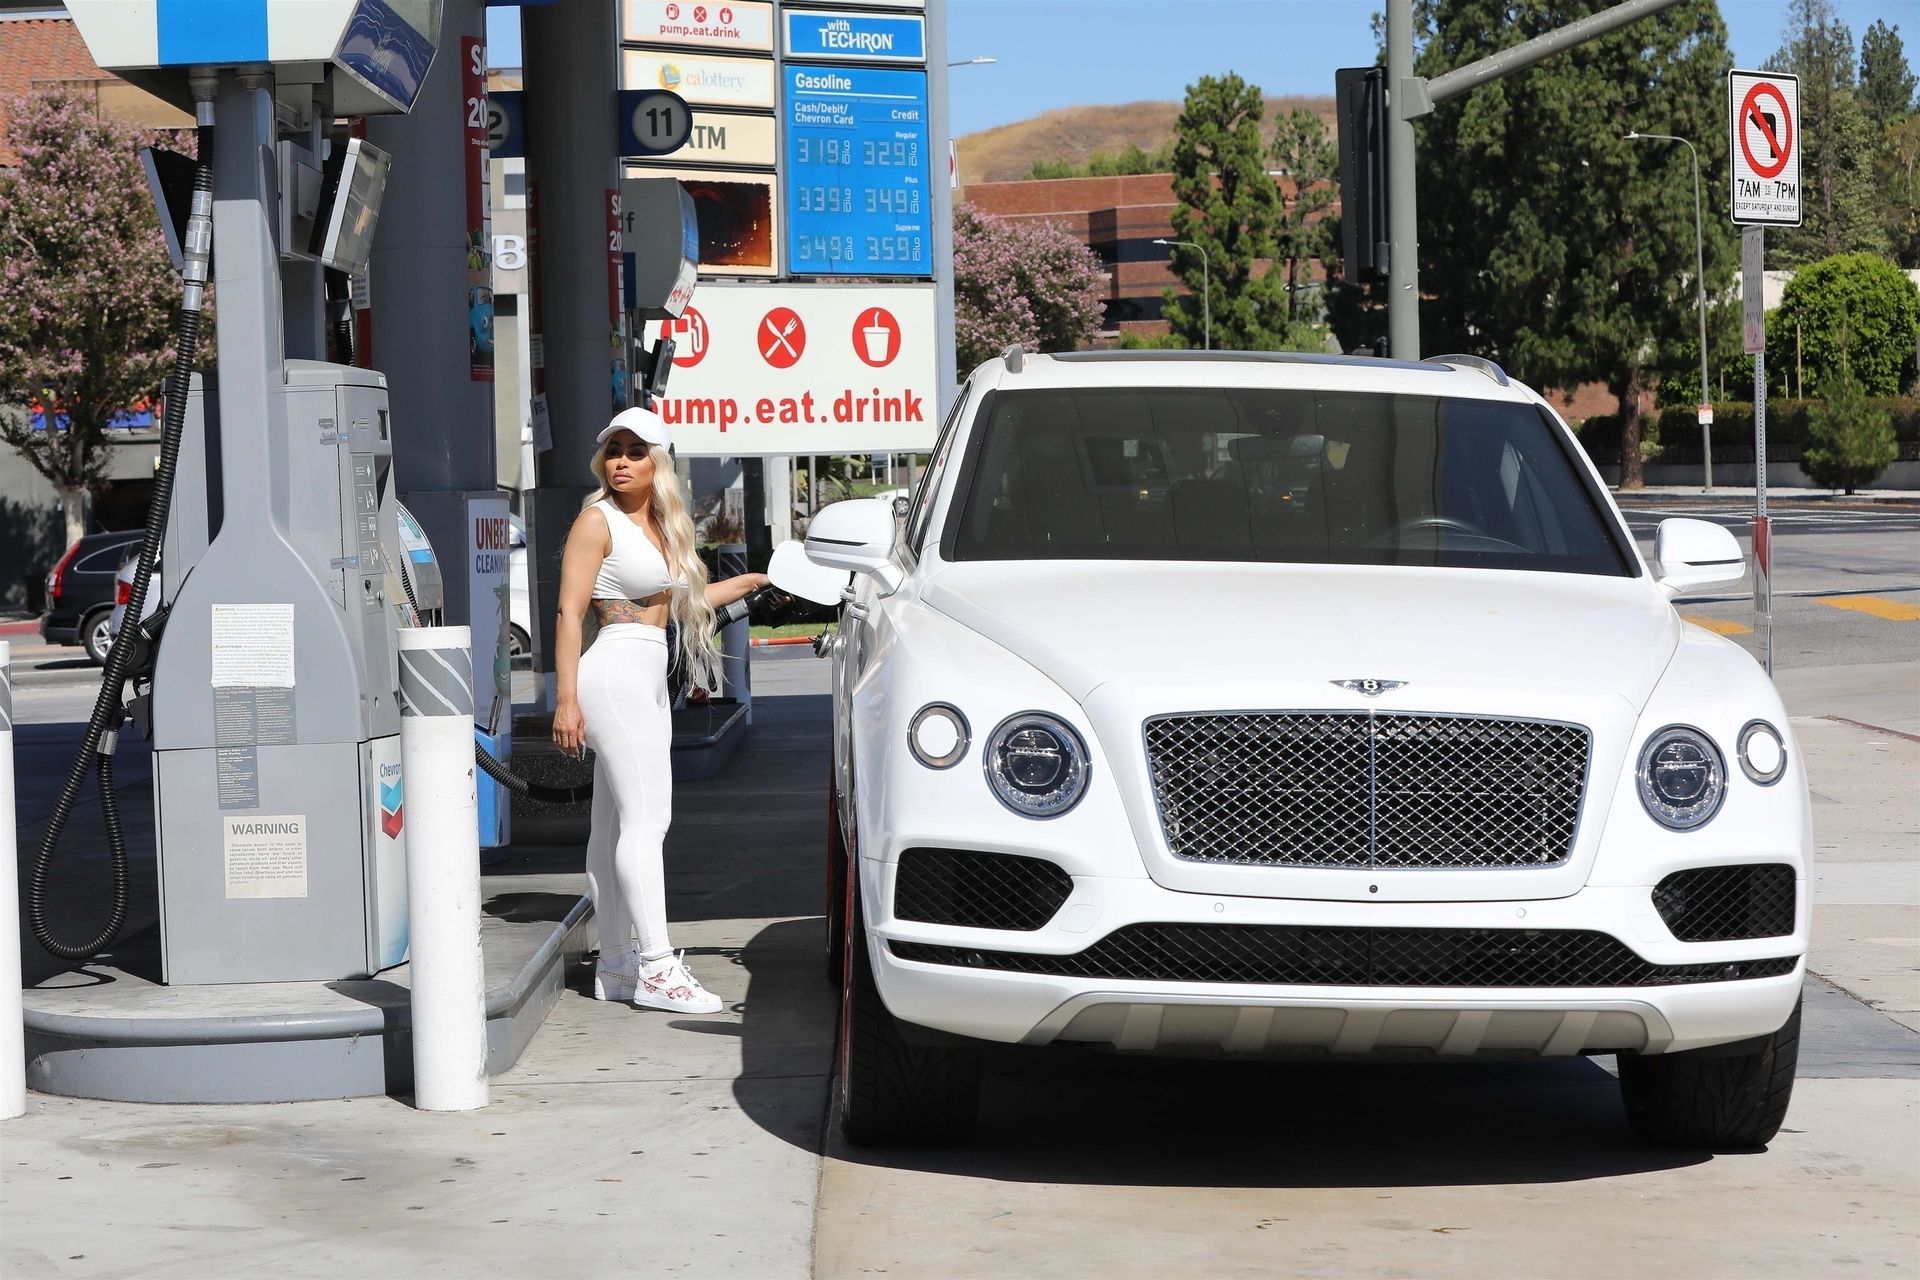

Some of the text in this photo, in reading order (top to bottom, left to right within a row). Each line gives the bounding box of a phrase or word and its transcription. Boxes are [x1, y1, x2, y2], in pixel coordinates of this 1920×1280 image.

[660, 25, 740, 38] pump.eat.drink
[827, 20, 850, 31] with
[818, 28, 893, 52] TECHRON
[686, 69, 745, 92] calottery
[795, 72, 852, 90] Gasoline
[795, 102, 848, 114] Cash/Debit/
[892, 110, 918, 120] Credit
[646, 108, 672, 137] 11
[795, 113, 854, 124] Chevron Card
[896, 132, 918, 140] Regular
[798, 138, 838, 164] 319
[864, 141, 906, 166] 329
[1738, 178, 1760, 198] 7AM
[1774, 180, 1796, 200] 7PM
[800, 186, 840, 212] 339
[864, 189, 908, 213] 349
[1736, 202, 1750, 210] EXCEPT
[1752, 202, 1772, 211] SATURDAY
[895, 224, 920, 232] Supreme
[866, 236, 910, 261] 359
[232, 822, 298, 834] WARNING
